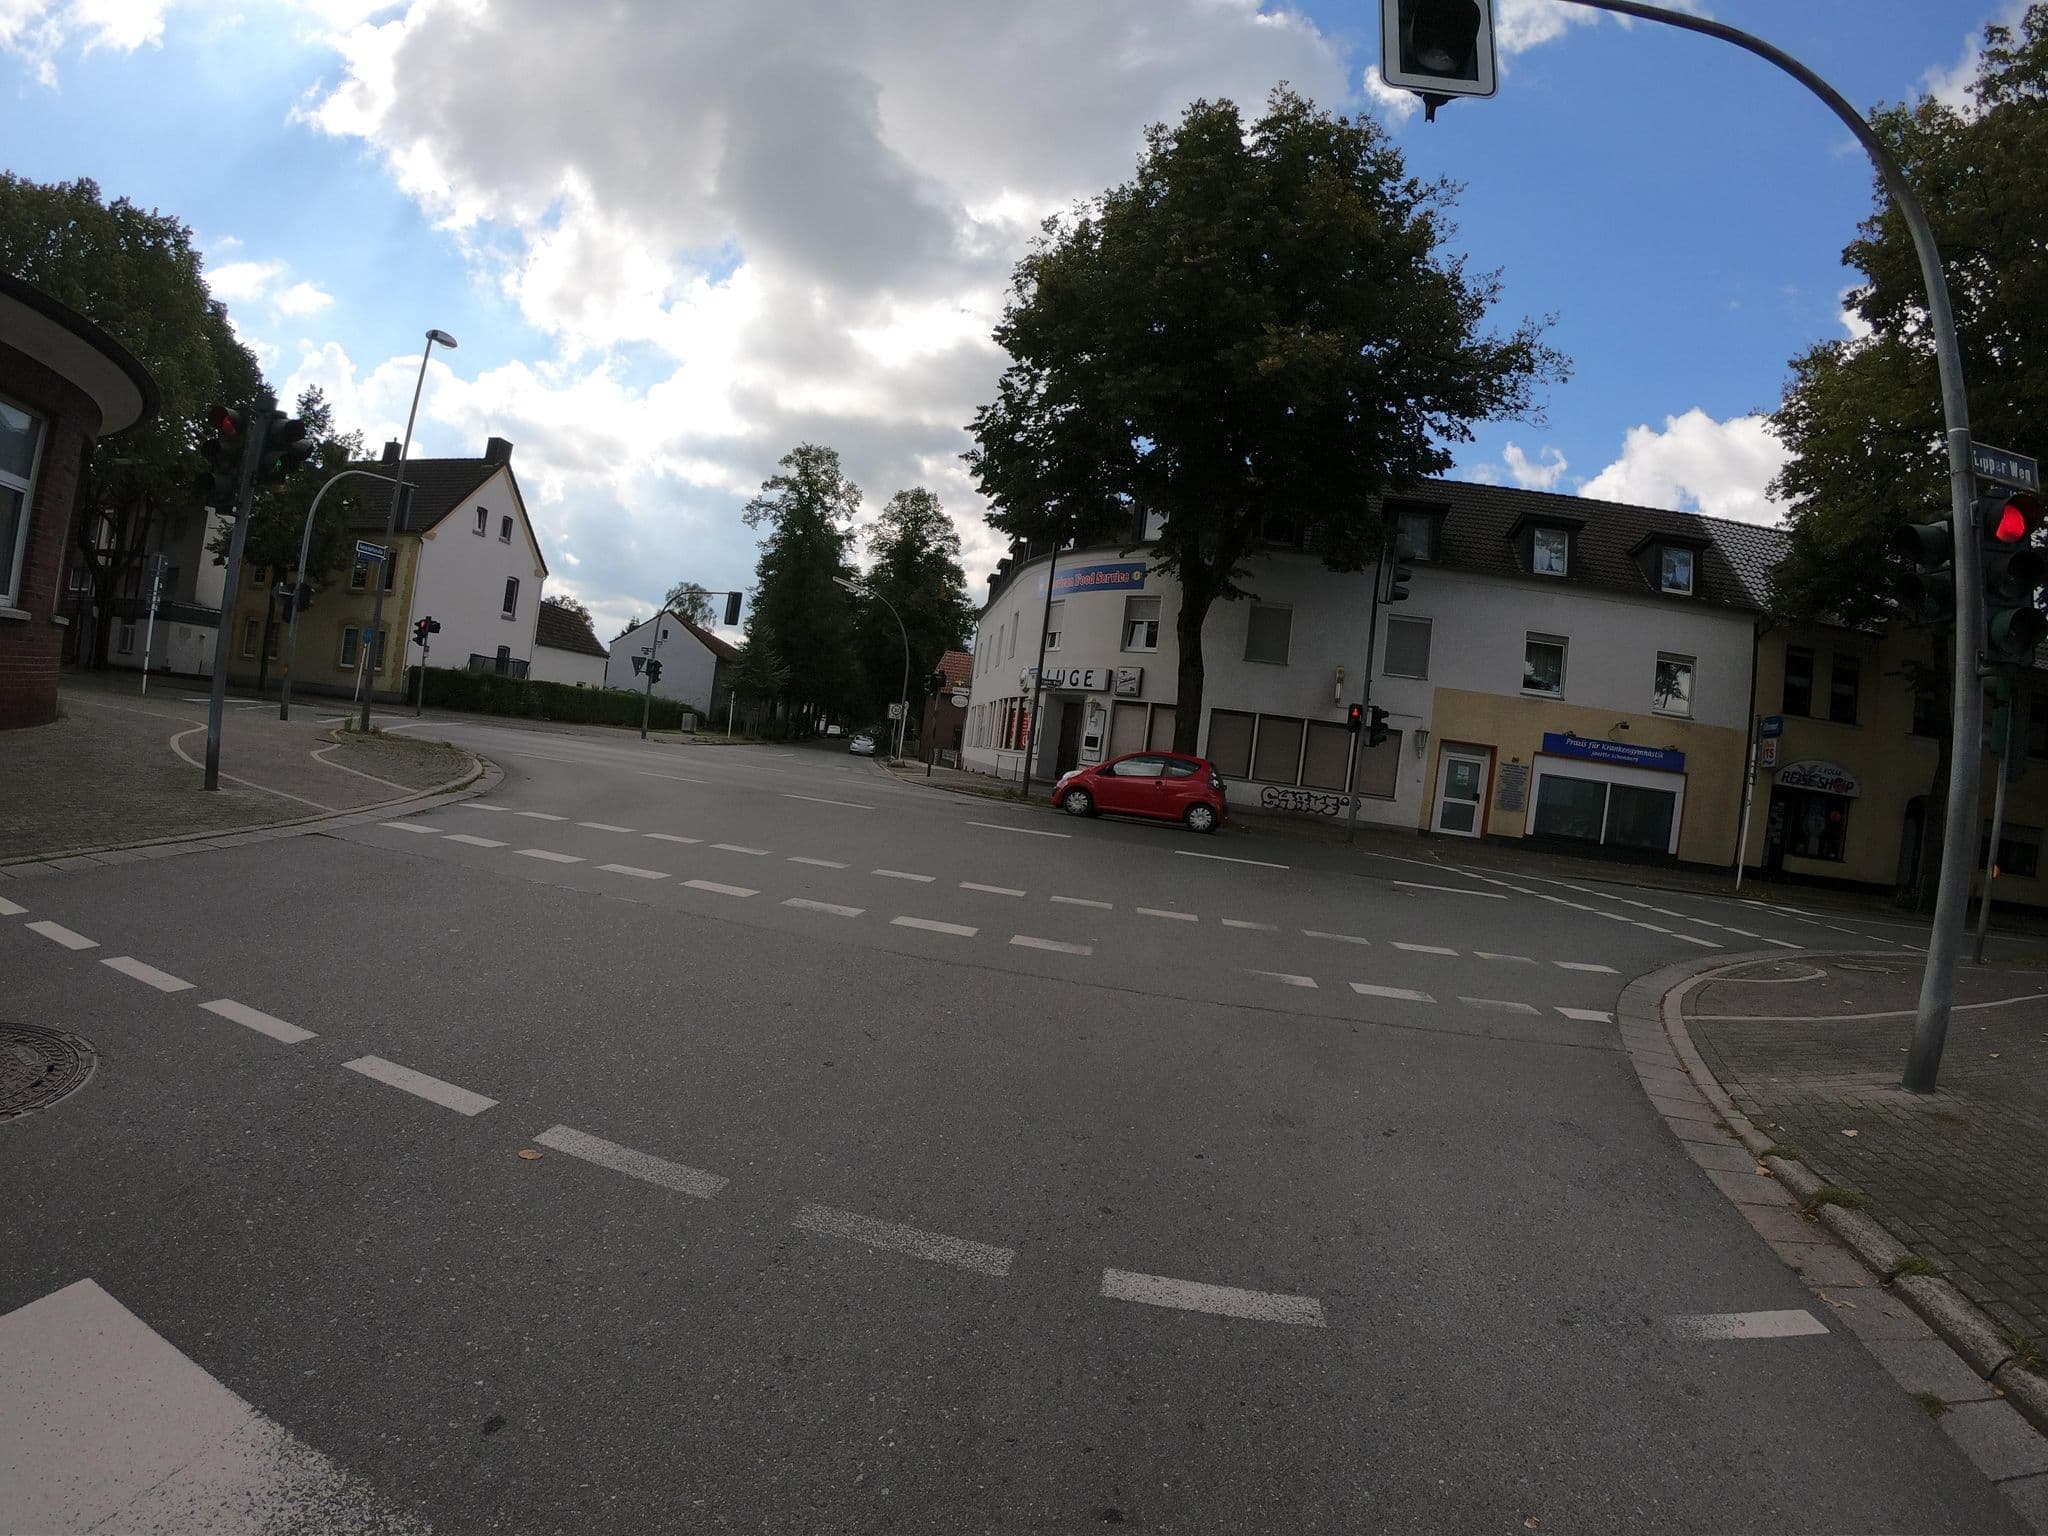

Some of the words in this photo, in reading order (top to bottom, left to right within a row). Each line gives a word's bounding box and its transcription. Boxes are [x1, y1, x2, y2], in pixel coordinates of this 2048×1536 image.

[1973, 450, 2007, 475] Lipper
[1075, 572, 1095, 586] Food
[1096, 570, 1129, 584] Service
[1565, 738, 1588, 748] Praxis
[1588, 740, 1600, 750] für
[1601, 743, 1665, 759] Krankengymnastik
[1781, 770, 1818, 786] REISE
